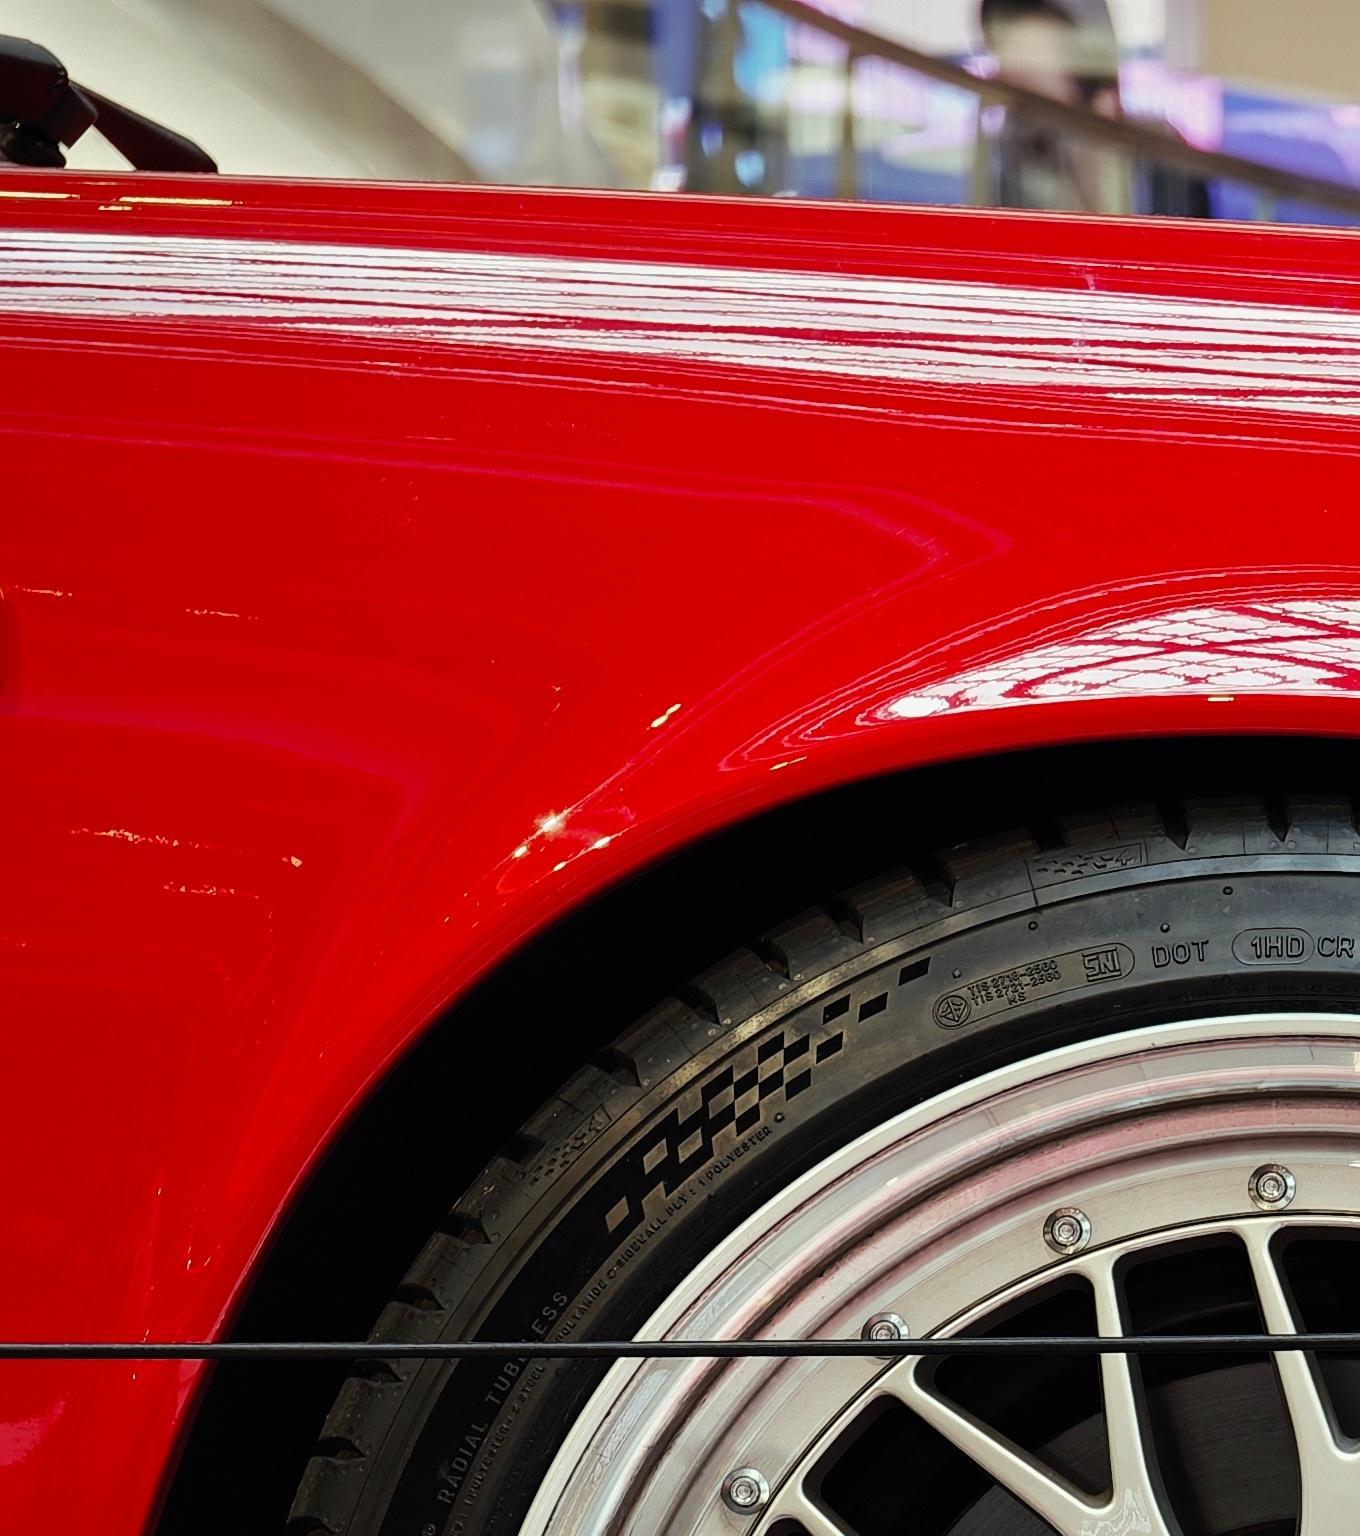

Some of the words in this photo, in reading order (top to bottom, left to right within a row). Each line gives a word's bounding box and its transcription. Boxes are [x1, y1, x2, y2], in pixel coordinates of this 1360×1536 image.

[1149, 938, 1211, 968] DOT
[1250, 935, 1306, 957] 1HD
[1317, 934, 1357, 958] CR
[702, 1121, 774, 1182] POLYESTER
[435, 1416, 489, 1505] RADIAL
[483, 1287, 570, 1408] TUBESS
